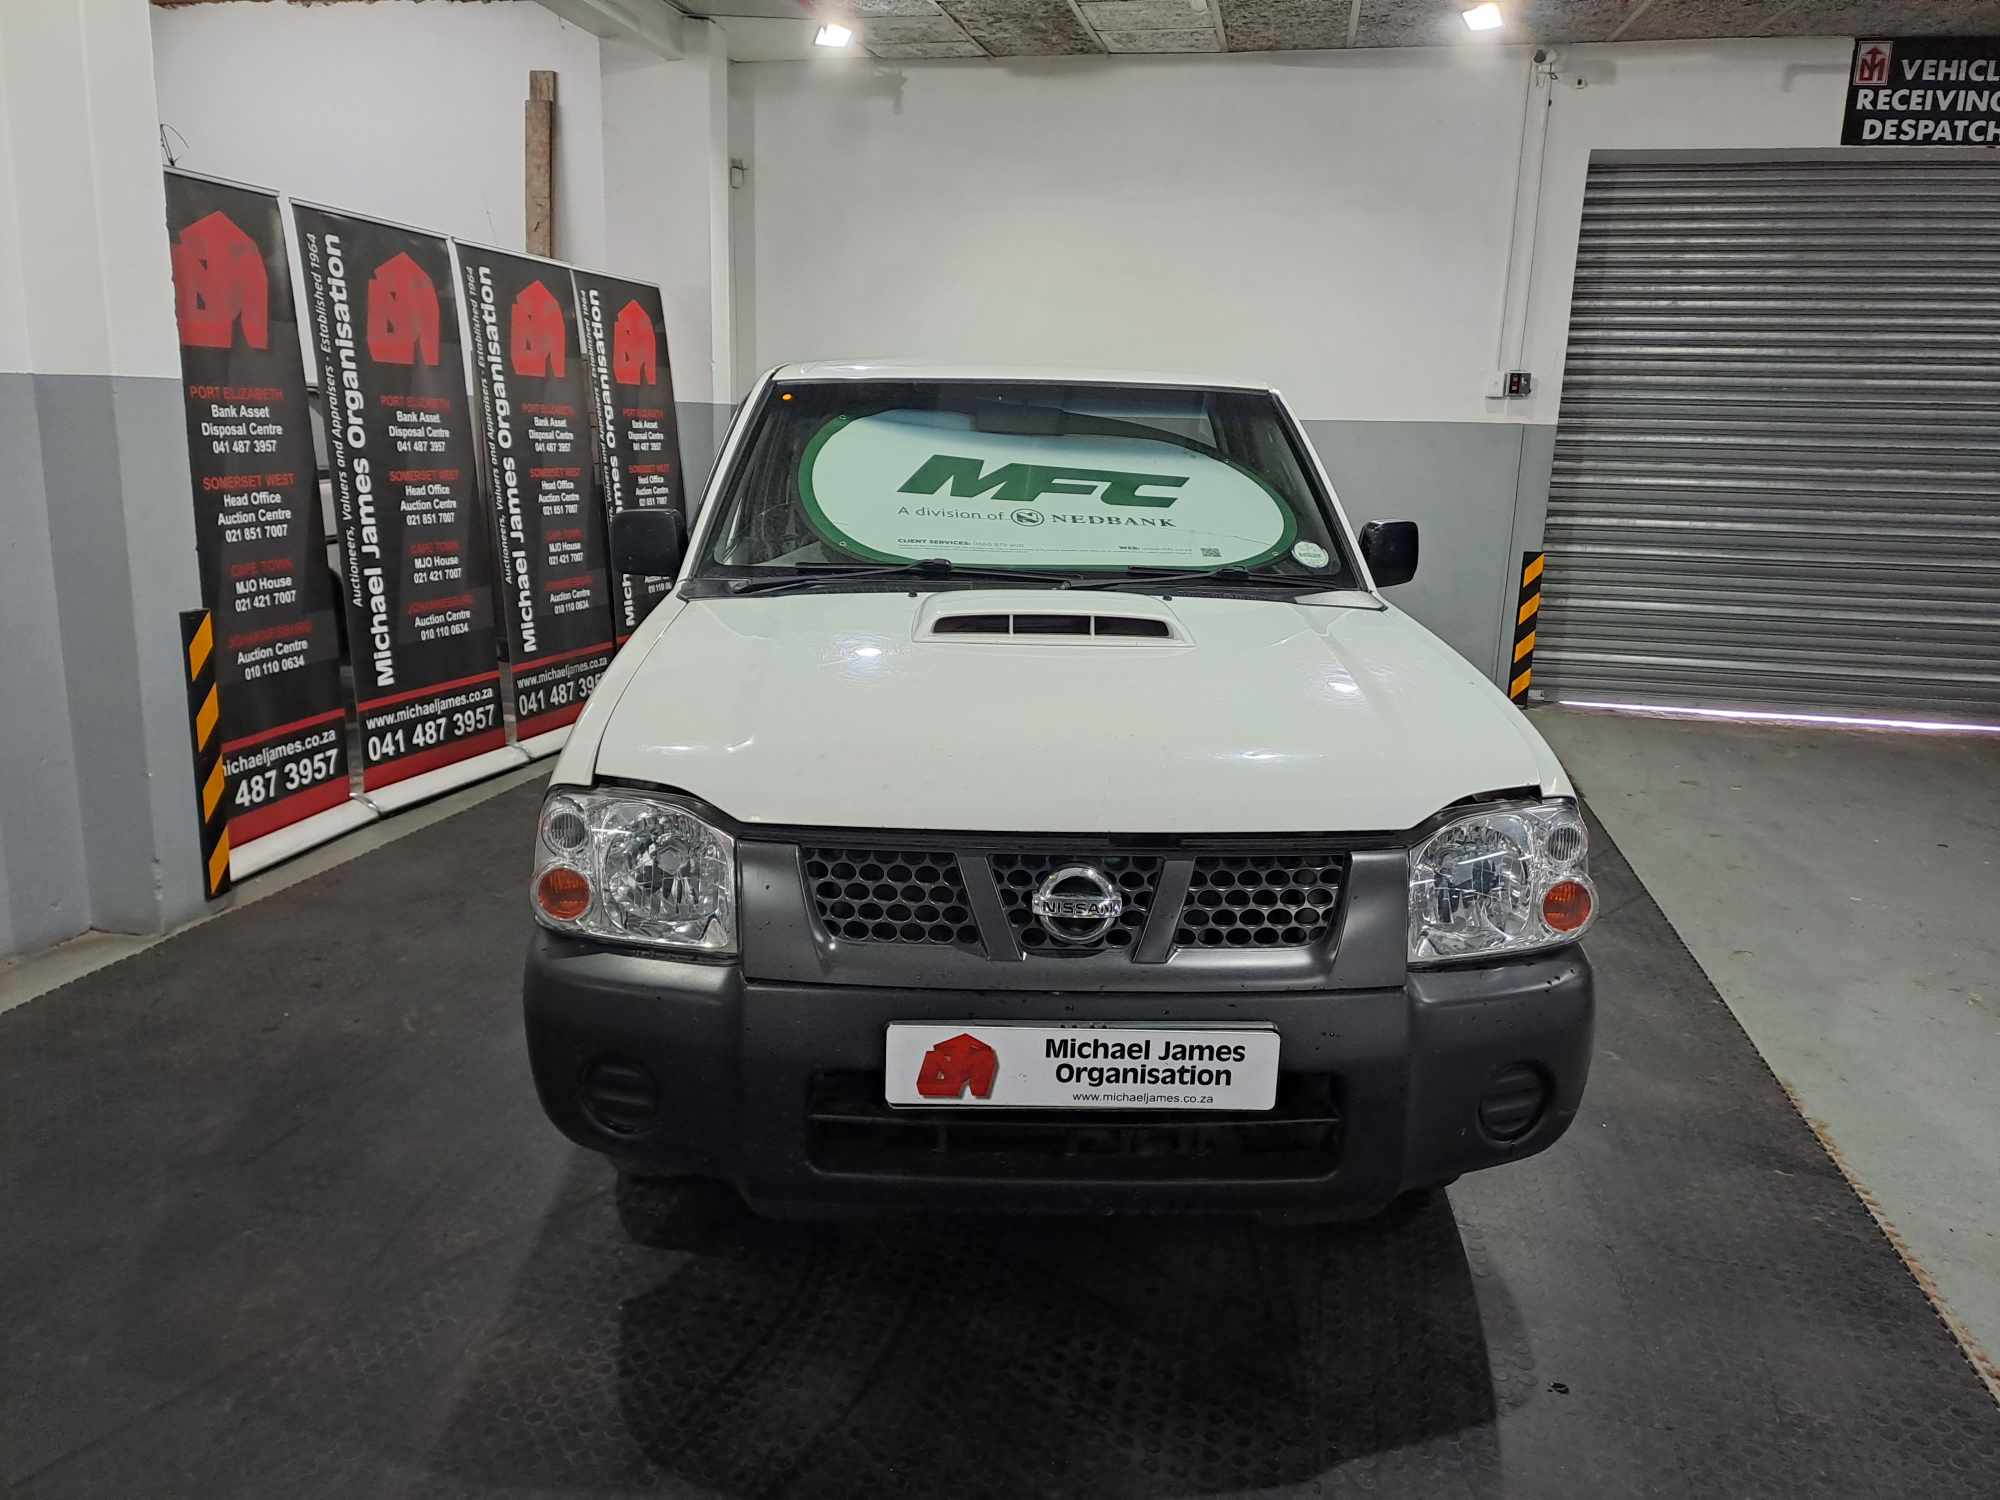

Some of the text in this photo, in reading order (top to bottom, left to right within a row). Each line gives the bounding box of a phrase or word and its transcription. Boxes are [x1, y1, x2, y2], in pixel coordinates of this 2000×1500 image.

[1862, 119, 2000, 142] DESPATCH
[306, 232, 322, 269] 1964
[314, 273, 331, 353] Established
[211, 404, 270, 418] Bank Asset
[325, 365, 343, 438] Appraisers
[396, 411, 418, 422] Bank
[202, 423, 283, 438] Disposal Centre
[388, 426, 424, 438] Disposal
[212, 440, 277, 454] 041 487 3957
[331, 440, 346, 468] and
[397, 442, 411, 452] 041
[324, 233, 395, 687] Michael James Organisation
[202, 473, 295, 490] SOMERSET WEST
[405, 485, 426, 496] Head
[610, 456, 624, 514] mes
[896, 454, 1190, 508] MFC
[224, 492, 282, 507] Head Office
[337, 469, 352, 521] Valuers
[503, 457, 524, 543] James
[400, 500, 432, 511] Auction
[898, 506, 1004, 520] A division of
[218, 508, 292, 526] Auction Centre
[406, 515, 420, 526] 021
[1052, 514, 1176, 528] NEDBANK
[226, 524, 288, 542] 021 851 7007
[344, 526, 363, 608] Auctioneers,
[414, 556, 458, 568] MJO House
[236, 576, 292, 594] MJO House
[414, 573, 428, 584] 021
[429, 570, 442, 581] 421
[235, 590, 296, 612] 021 421 7007
[512, 550, 537, 652] Michael
[622, 574, 636, 627] Mich
[414, 610, 470, 627] Auction Centre
[436, 625, 449, 636] 110
[238, 640, 308, 664] Auction Centre
[245, 655, 304, 680] 010 110 0634
[519, 674, 603, 716] 041 487 39
[366, 688, 493, 730] www.michaeljames.co.za
[368, 704, 495, 761] 041 487 3957
[235, 748, 338, 806] 487 3957
[1042, 902, 1112, 914] NISSAN
[1046, 1038, 1246, 1062] Michael James
[1056, 1063, 1232, 1086] Organisation
[1073, 1092, 1214, 1104] www.michaeljames.co.za
